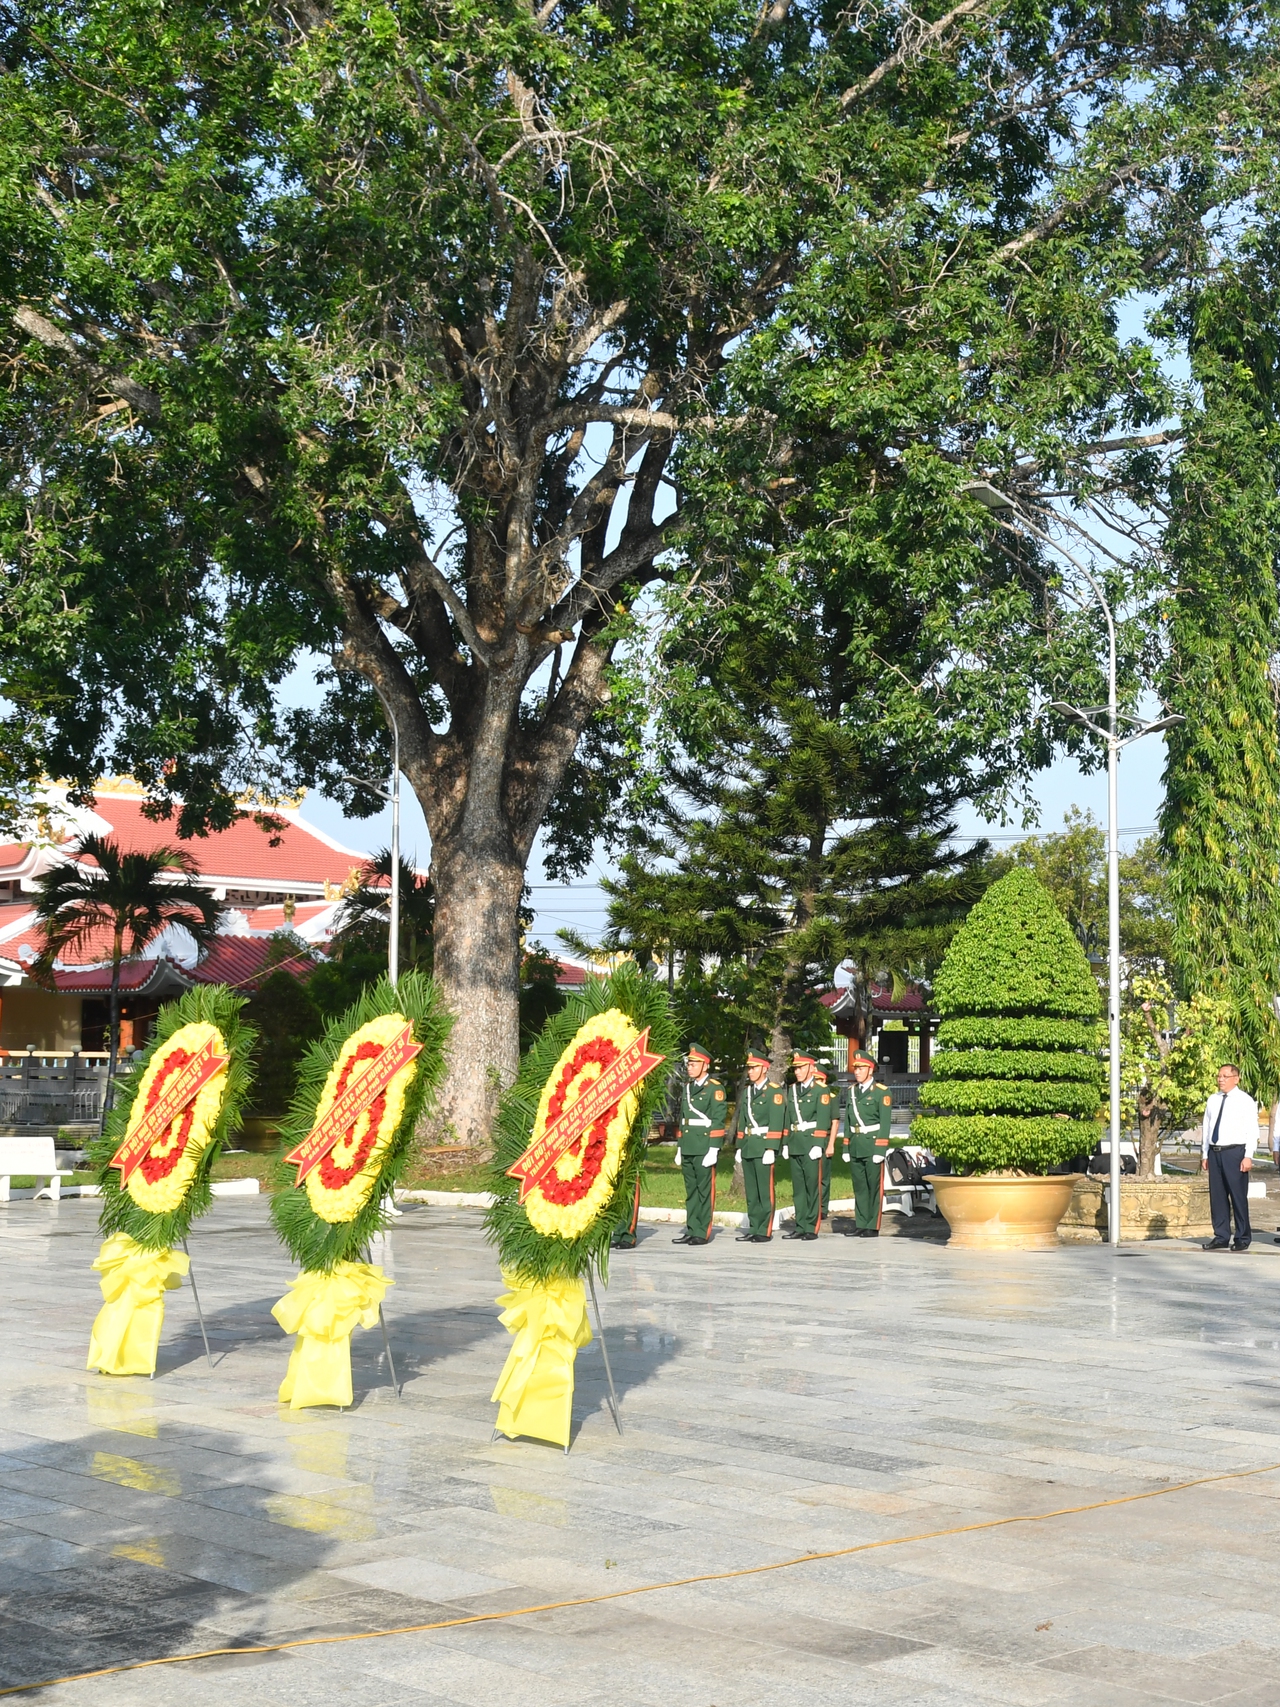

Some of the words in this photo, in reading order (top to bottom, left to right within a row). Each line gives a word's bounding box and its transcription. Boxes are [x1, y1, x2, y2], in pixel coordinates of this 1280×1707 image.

[166, 1088, 178, 1105] ANH
[342, 1093, 355, 1110] CÁC
[355, 1079, 368, 1096] ANH
[367, 1061, 384, 1083] HÙNG
[383, 1045, 397, 1064] LIỆT
[569, 1103, 583, 1122] CÁC
[583, 1089, 597, 1108] ANH
[597, 1070, 617, 1093] HÙNG
[615, 1054, 632, 1075] LIỆT
[308, 1146, 319, 1160] BAN
